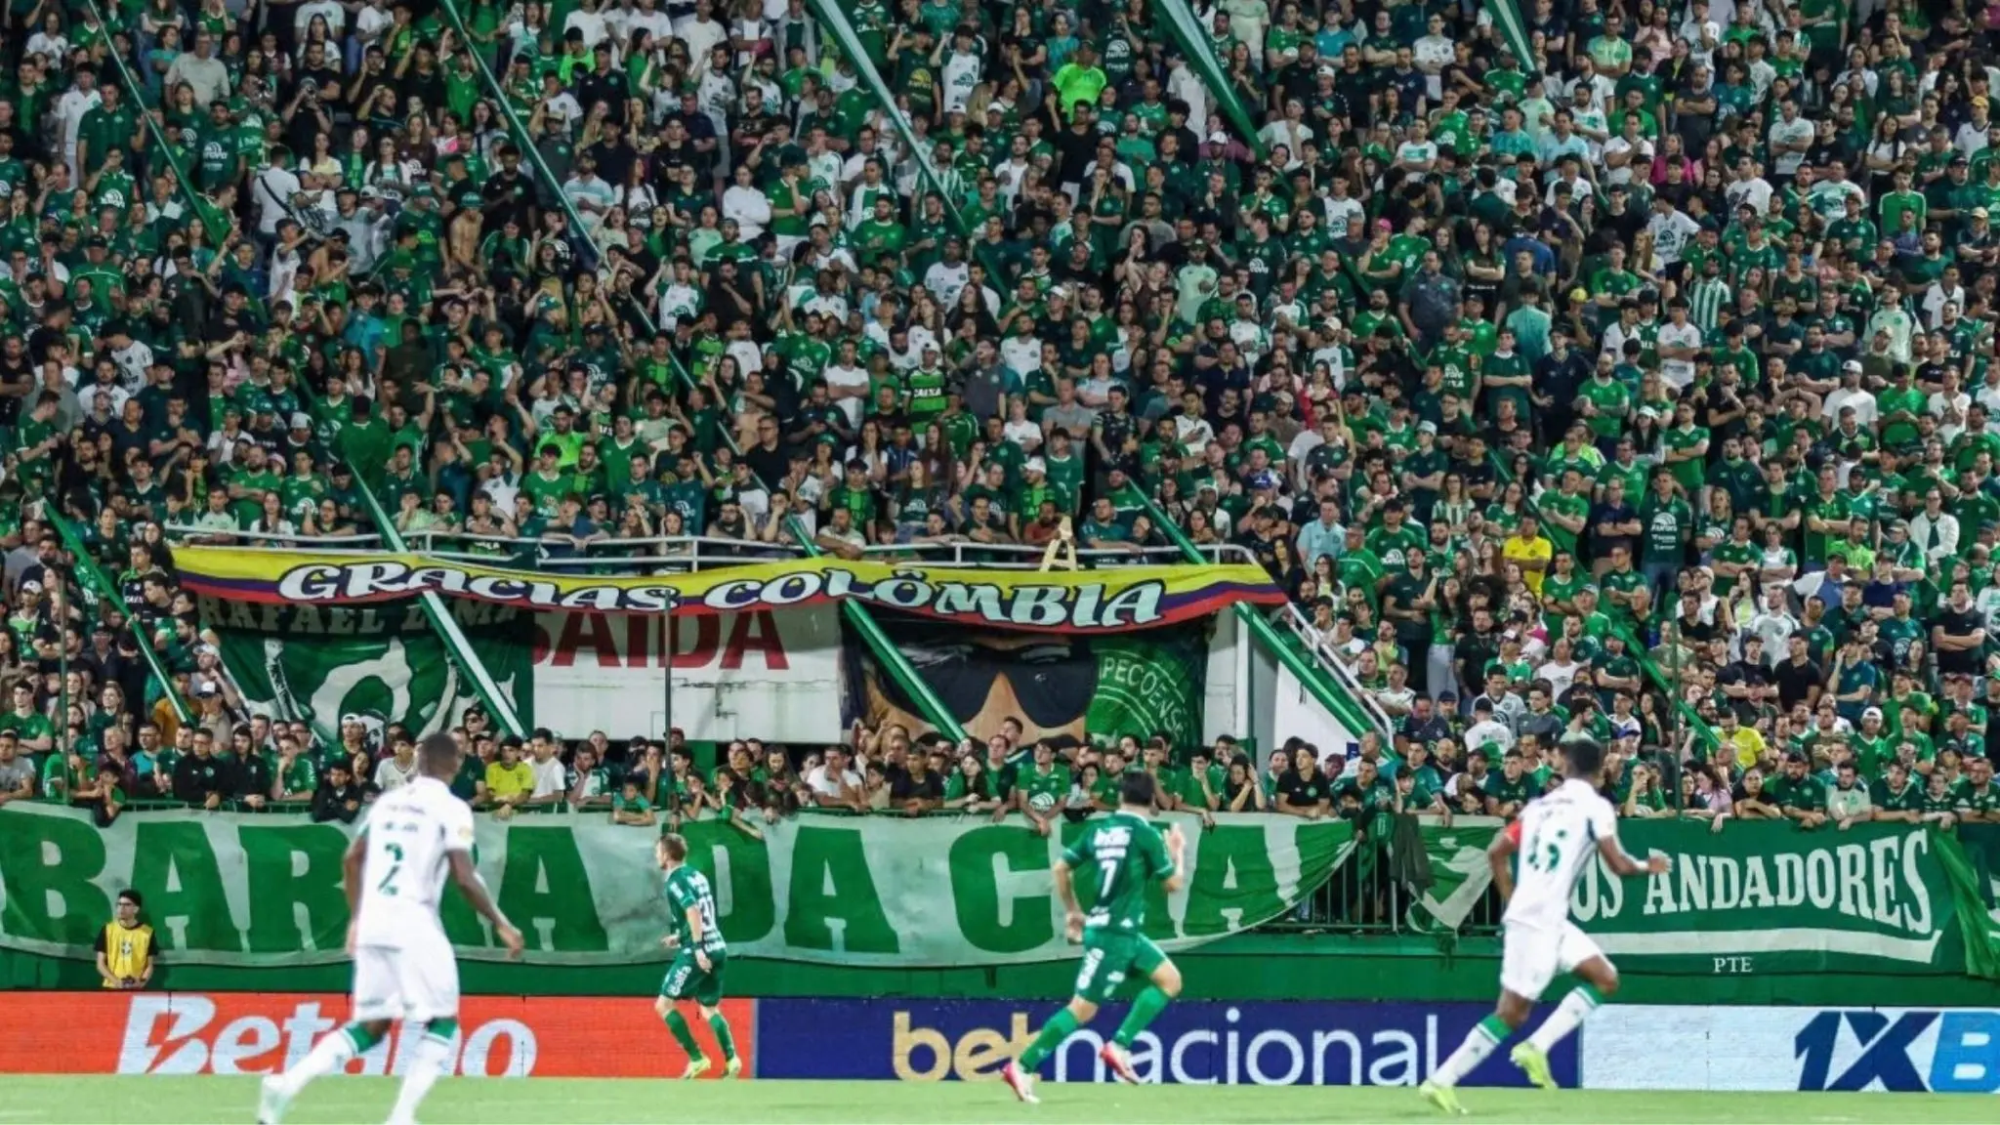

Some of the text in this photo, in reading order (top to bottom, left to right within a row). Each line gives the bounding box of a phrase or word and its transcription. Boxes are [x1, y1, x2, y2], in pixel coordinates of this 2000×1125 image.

[278, 561, 1165, 629] GRACIAS COLÔMBIA
[0, 809, 609, 951] BARA
[662, 818, 900, 954] DA
[377, 842, 404, 896] 2
[1100, 859, 1118, 898] 7
[1643, 828, 1932, 934] ANDADORES
[1713, 956, 1753, 973] PTE
[1794, 1010, 2000, 1093] 1XB
